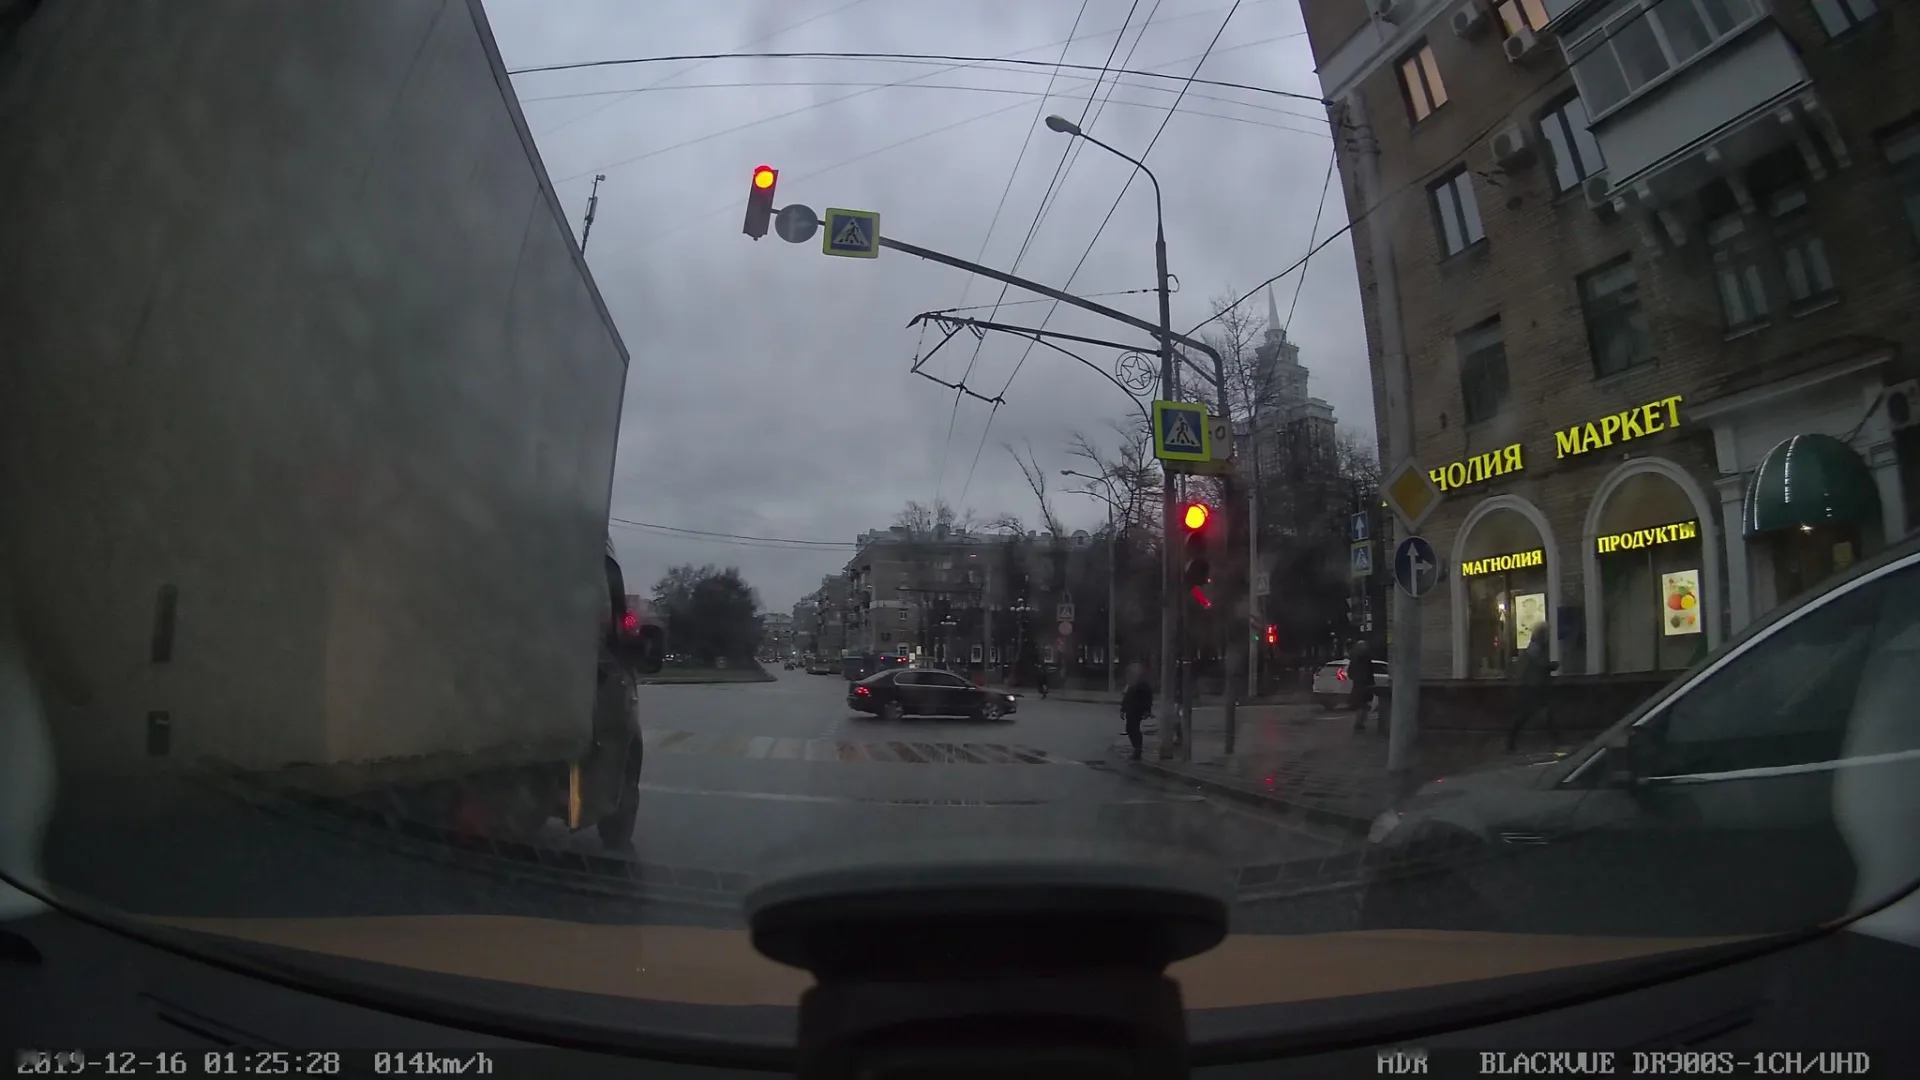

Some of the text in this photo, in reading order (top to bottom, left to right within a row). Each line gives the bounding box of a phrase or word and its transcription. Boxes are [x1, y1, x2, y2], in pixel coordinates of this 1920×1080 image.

[1554, 395, 1683, 459] МАРКЕТ
[1597, 521, 1697, 554] ПРОДУКТЫ
[1461, 548, 1544, 577] МАГНОЛИЯ
